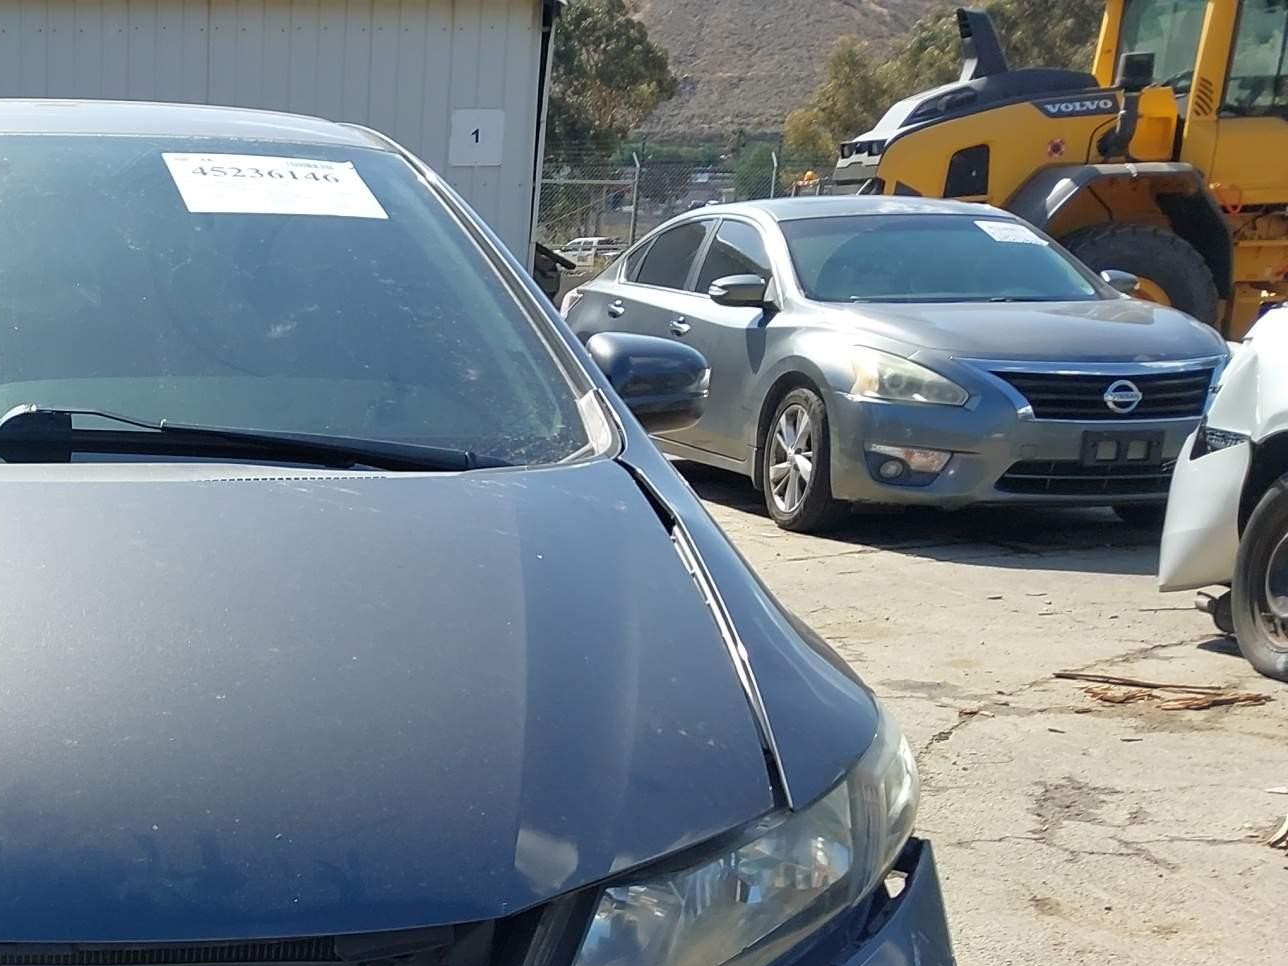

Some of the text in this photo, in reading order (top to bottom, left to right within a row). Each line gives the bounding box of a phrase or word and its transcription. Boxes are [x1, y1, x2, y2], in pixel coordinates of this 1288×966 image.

[1043, 99, 1113, 113] VOLVO
[471, 128, 480, 144] 1
[191, 165, 341, 184] 45236146
